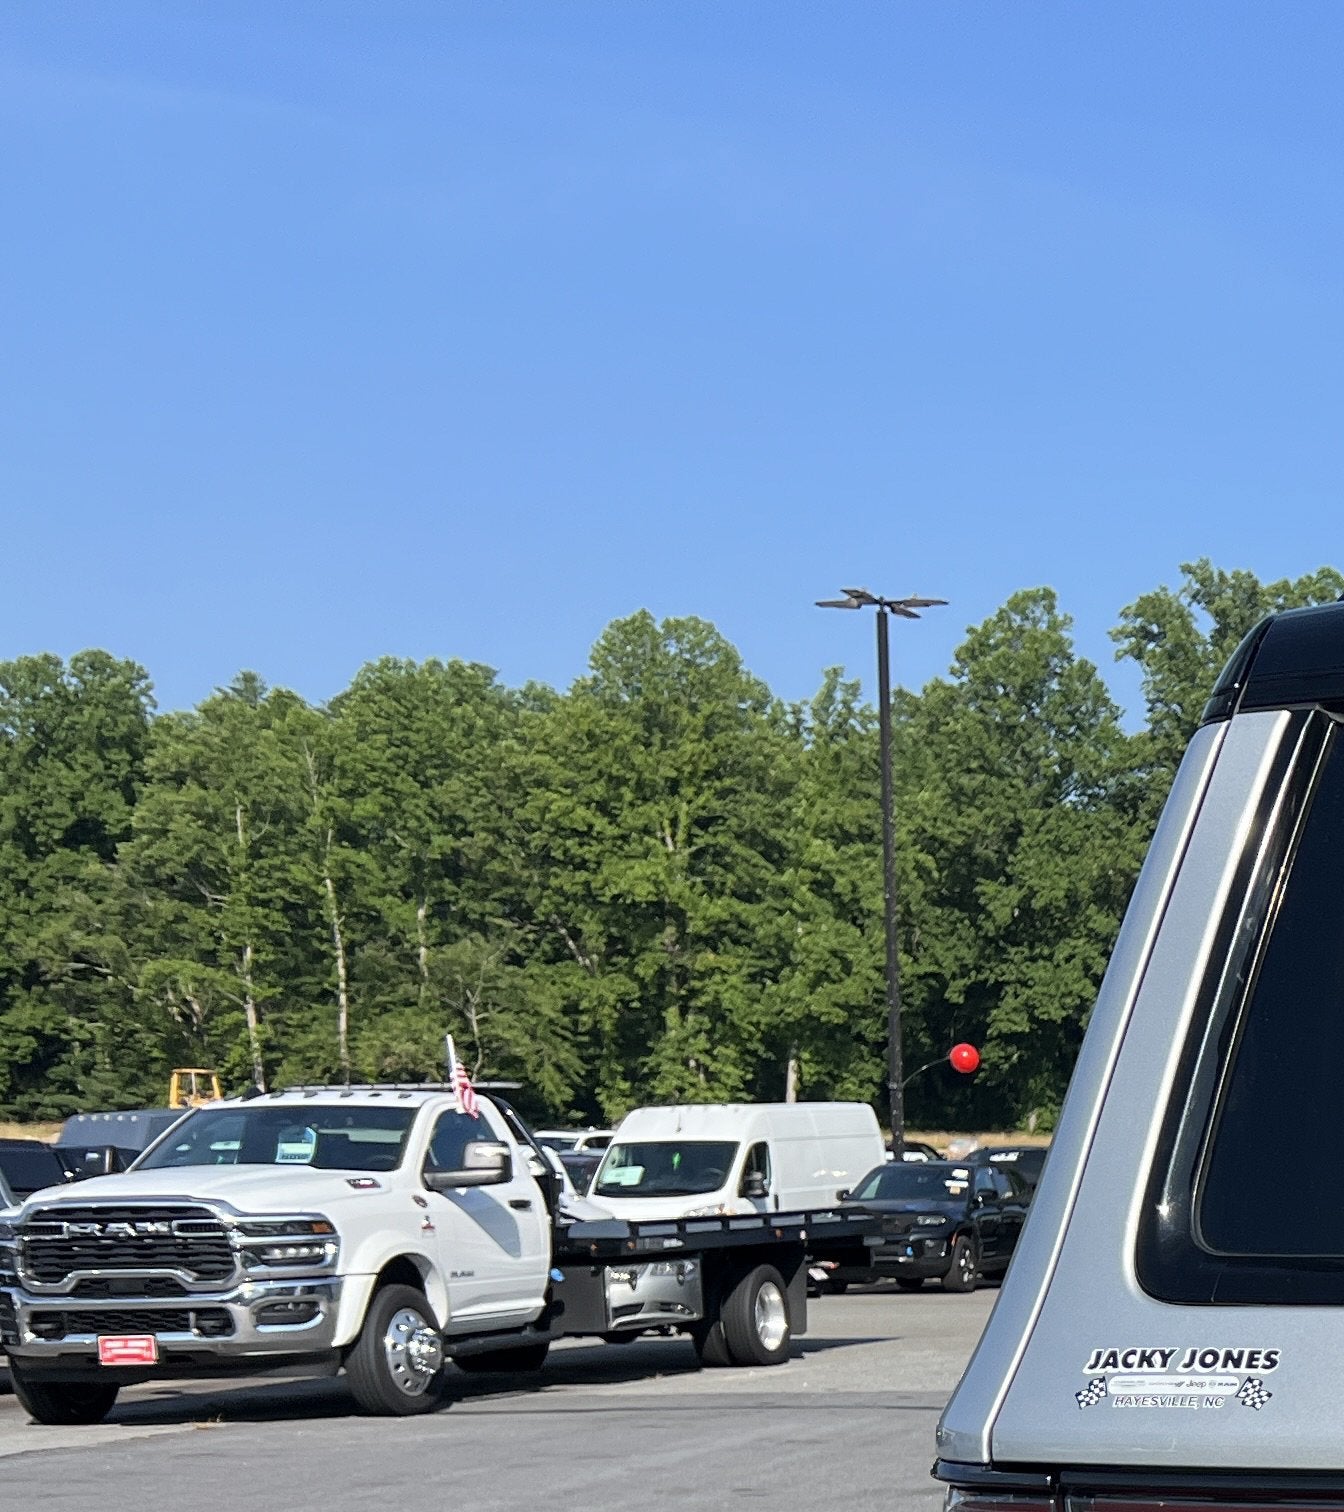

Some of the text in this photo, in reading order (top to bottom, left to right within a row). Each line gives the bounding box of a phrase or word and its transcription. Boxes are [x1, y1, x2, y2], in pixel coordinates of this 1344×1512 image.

[1083, 1347, 1281, 1374] JACKY JONES
[1203, 1396, 1226, 1408] NC
